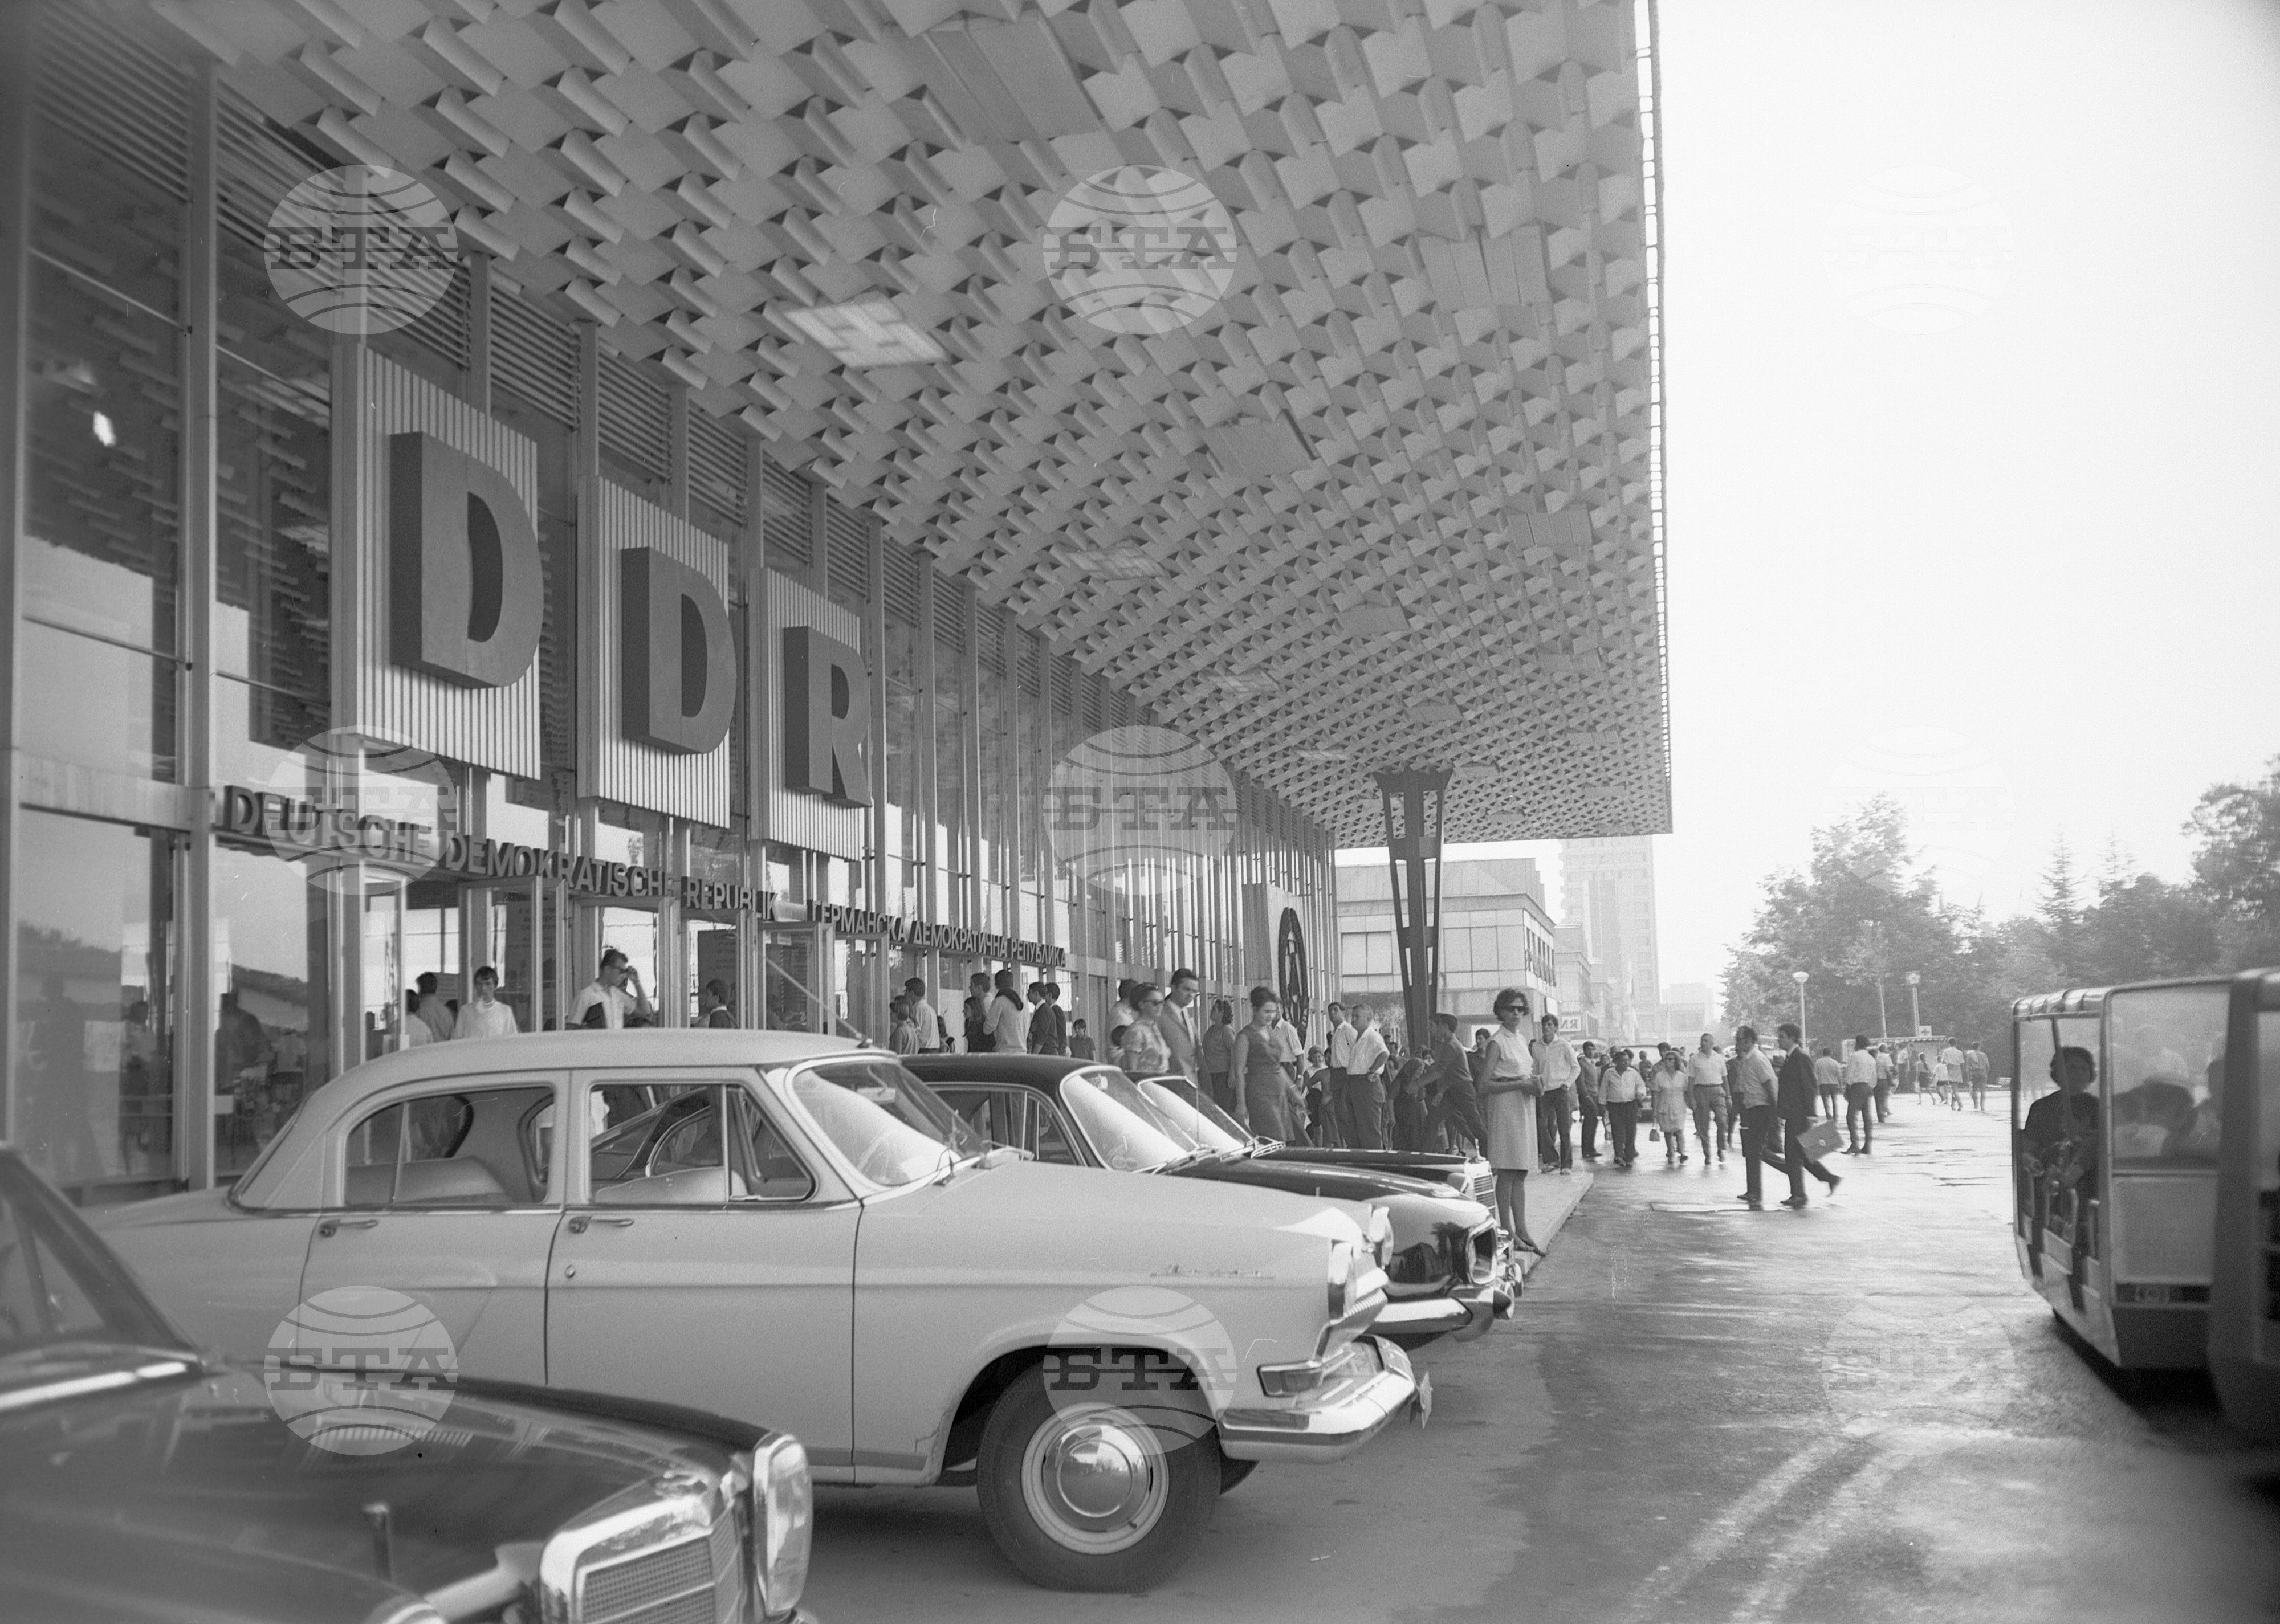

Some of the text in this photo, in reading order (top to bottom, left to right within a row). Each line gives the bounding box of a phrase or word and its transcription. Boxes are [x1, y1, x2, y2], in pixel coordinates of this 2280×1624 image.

[390, 431, 872, 807] DDR
[221, 785, 777, 919] DEUTSCHE DEMOKRATISCHE REPUBLIK
[810, 901, 1066, 968] ГЕРМАНСКА ДЕМОКРАТИЧНА РЕПУБЛИКА
